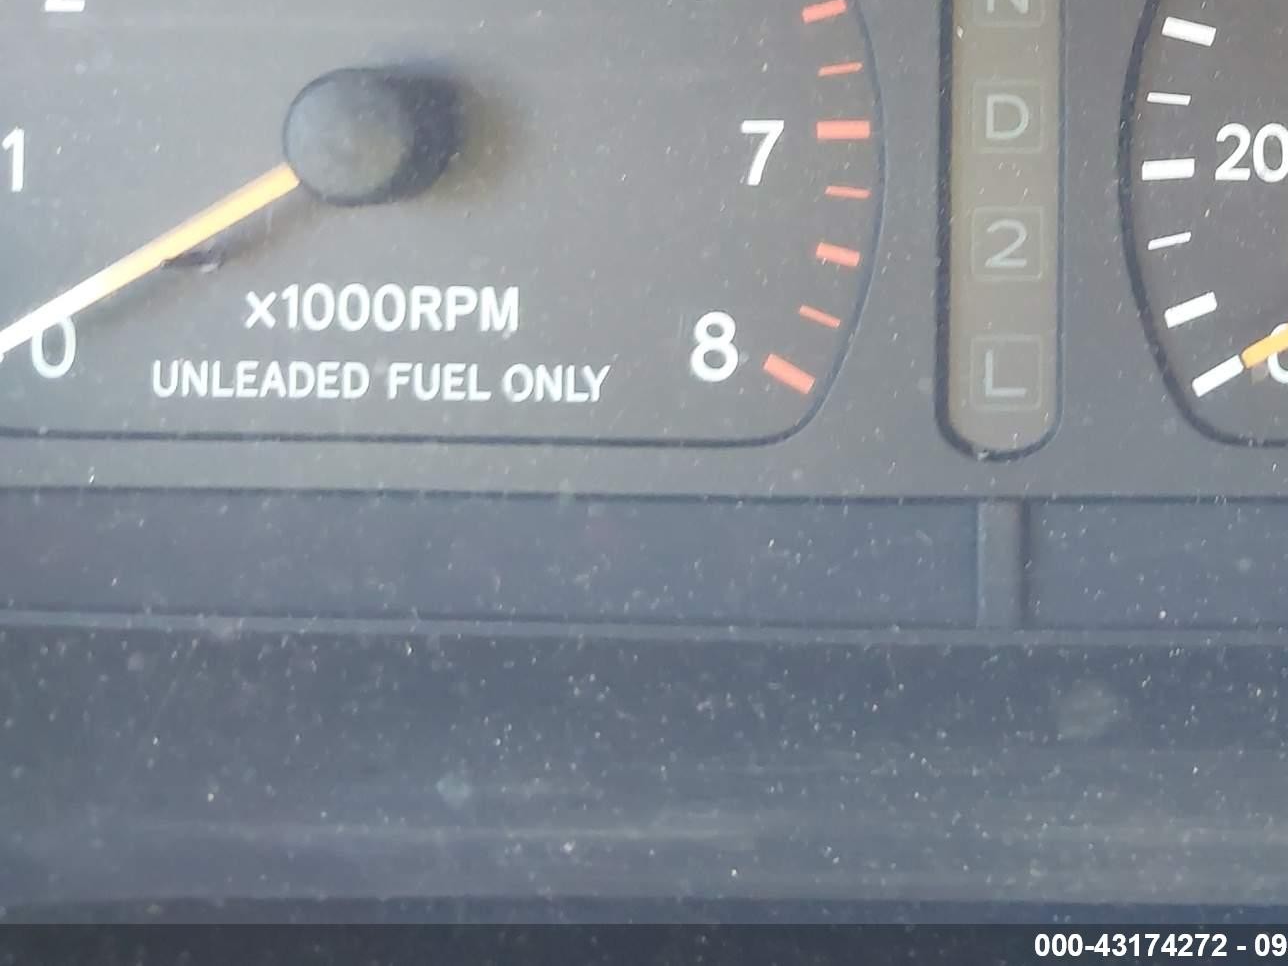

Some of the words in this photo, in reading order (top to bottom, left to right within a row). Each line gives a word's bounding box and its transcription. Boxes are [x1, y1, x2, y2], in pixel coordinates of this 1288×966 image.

[985, 94, 1030, 140] D
[1, 126, 25, 192] 1
[740, 119, 785, 186] 7
[985, 219, 1028, 268] 2
[31, 314, 77, 379] 0
[690, 311, 739, 382] 8
[983, 351, 1027, 398] L
[152, 359, 370, 399] UNLEADED
[387, 362, 492, 401] FUEL
[502, 363, 611, 403] ONLY
